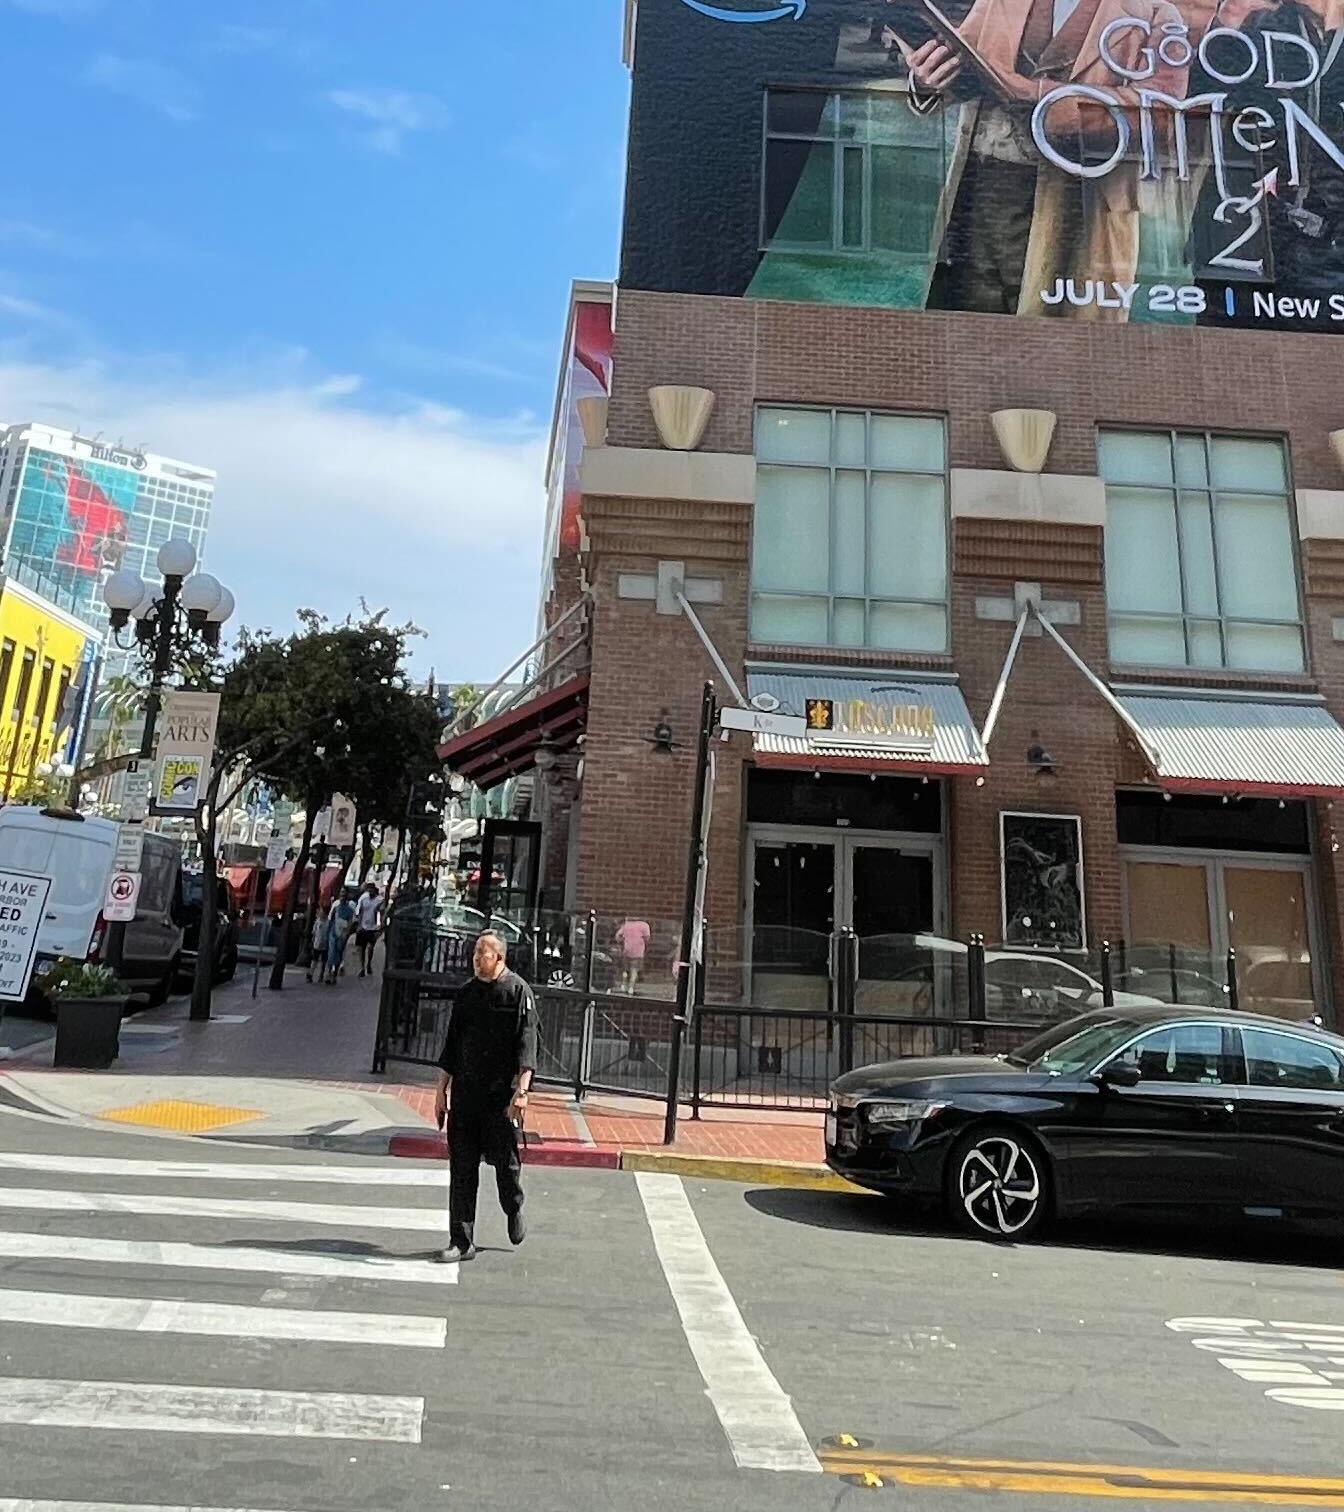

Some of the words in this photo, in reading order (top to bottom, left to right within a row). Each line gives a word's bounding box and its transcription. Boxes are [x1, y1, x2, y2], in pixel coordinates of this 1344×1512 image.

[1039, 278, 1140, 311] JULY
[1148, 284, 1207, 314] 28
[1253, 291, 1323, 321] New
[90, 445, 129, 467] Hilton
[753, 714, 763, 729] K
[162, 725, 211, 743] ARTS
[9, 881, 38, 897] AVE
